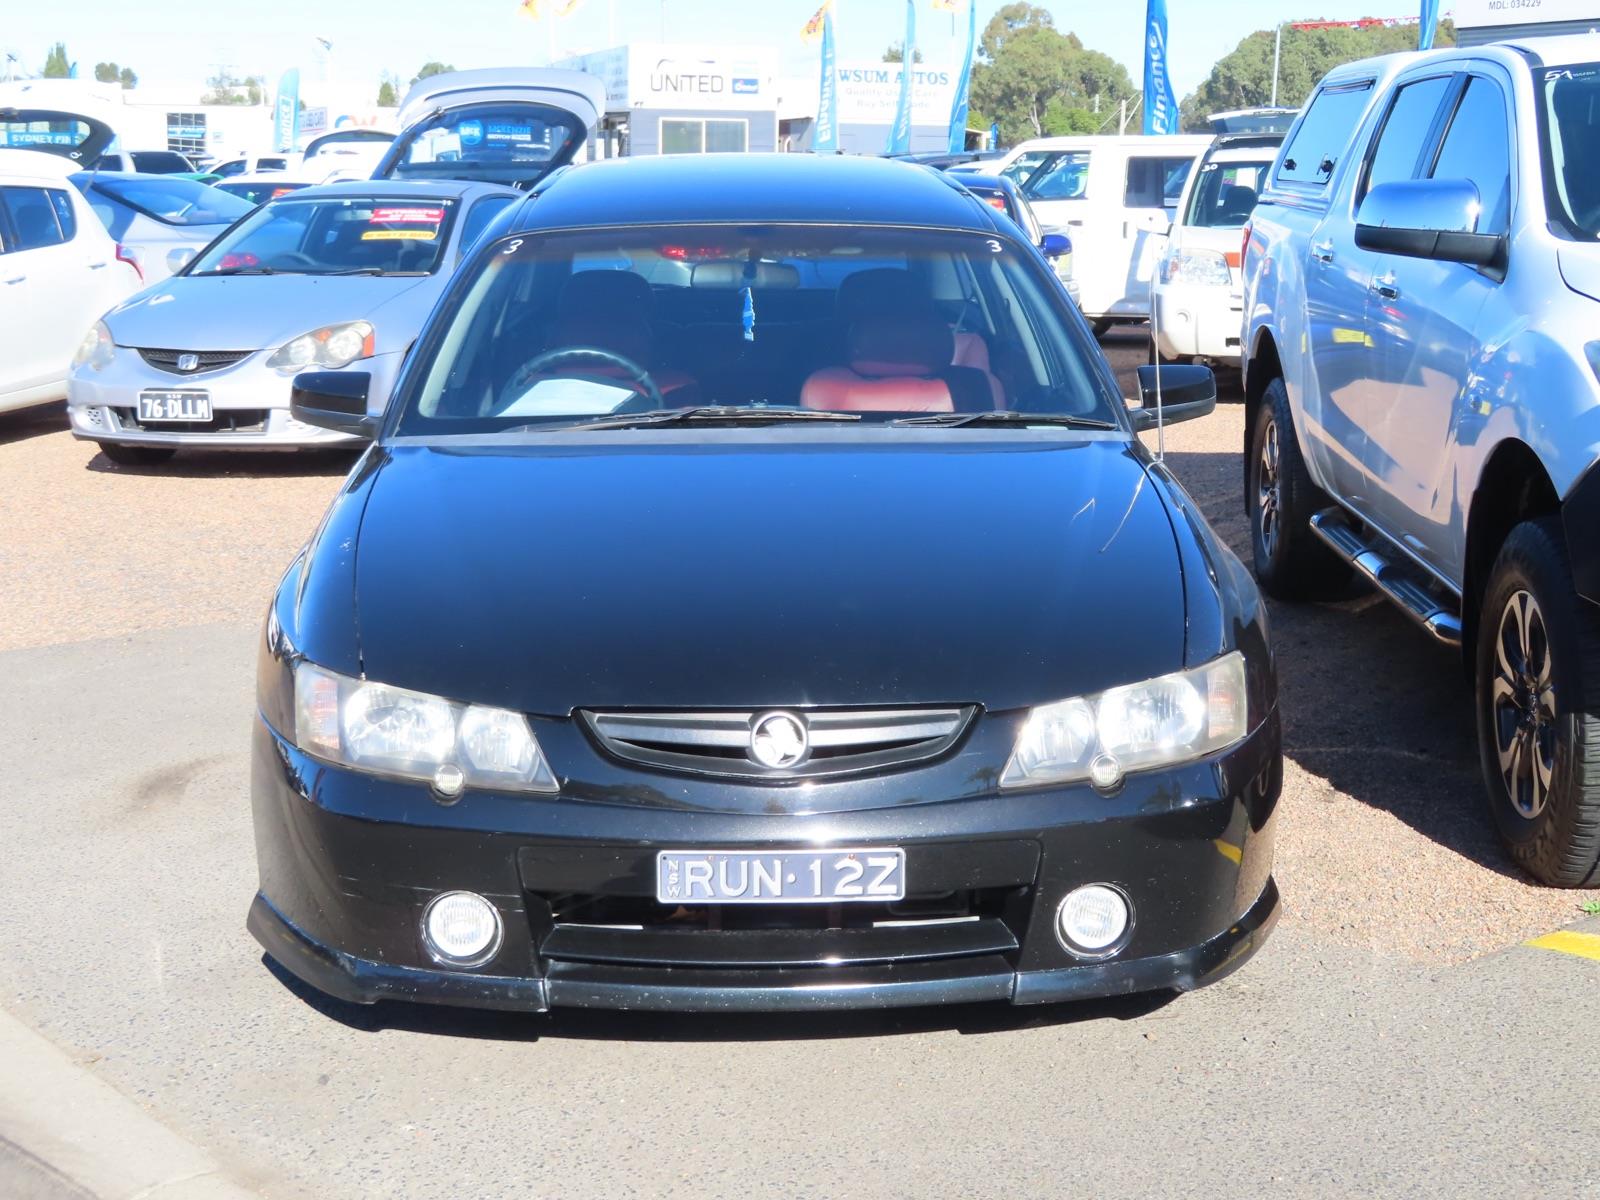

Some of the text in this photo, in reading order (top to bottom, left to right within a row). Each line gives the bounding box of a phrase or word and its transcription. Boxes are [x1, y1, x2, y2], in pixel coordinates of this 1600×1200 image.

[838, 69, 949, 86] WSUM ATOS
[1149, 35, 1168, 135] Finance
[279, 104, 292, 150] inance
[503, 239, 524, 254] 3
[986, 240, 1003, 252] 3
